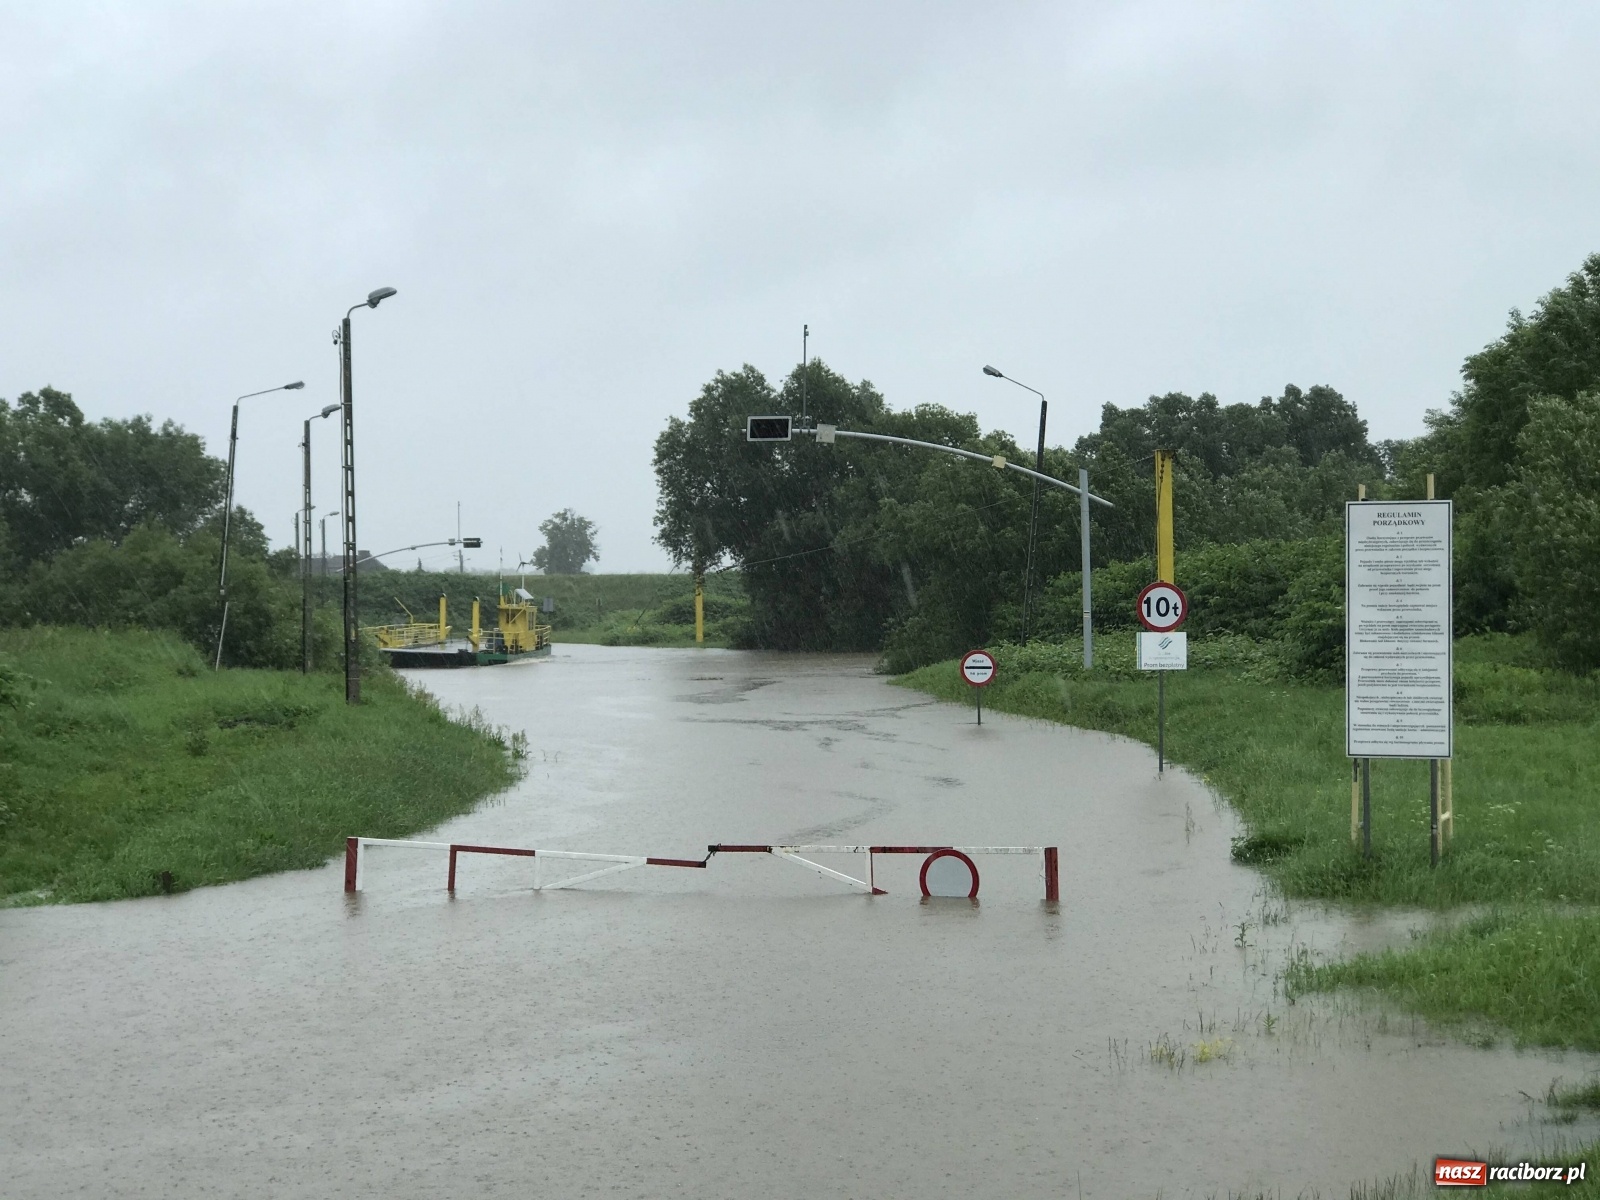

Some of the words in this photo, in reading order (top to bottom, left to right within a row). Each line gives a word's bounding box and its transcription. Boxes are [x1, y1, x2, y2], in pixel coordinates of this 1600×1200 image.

[1373, 519, 1426, 527] PORZĄDKOWY
[1143, 597, 1170, 617] 10
[1172, 602, 1179, 617] t
